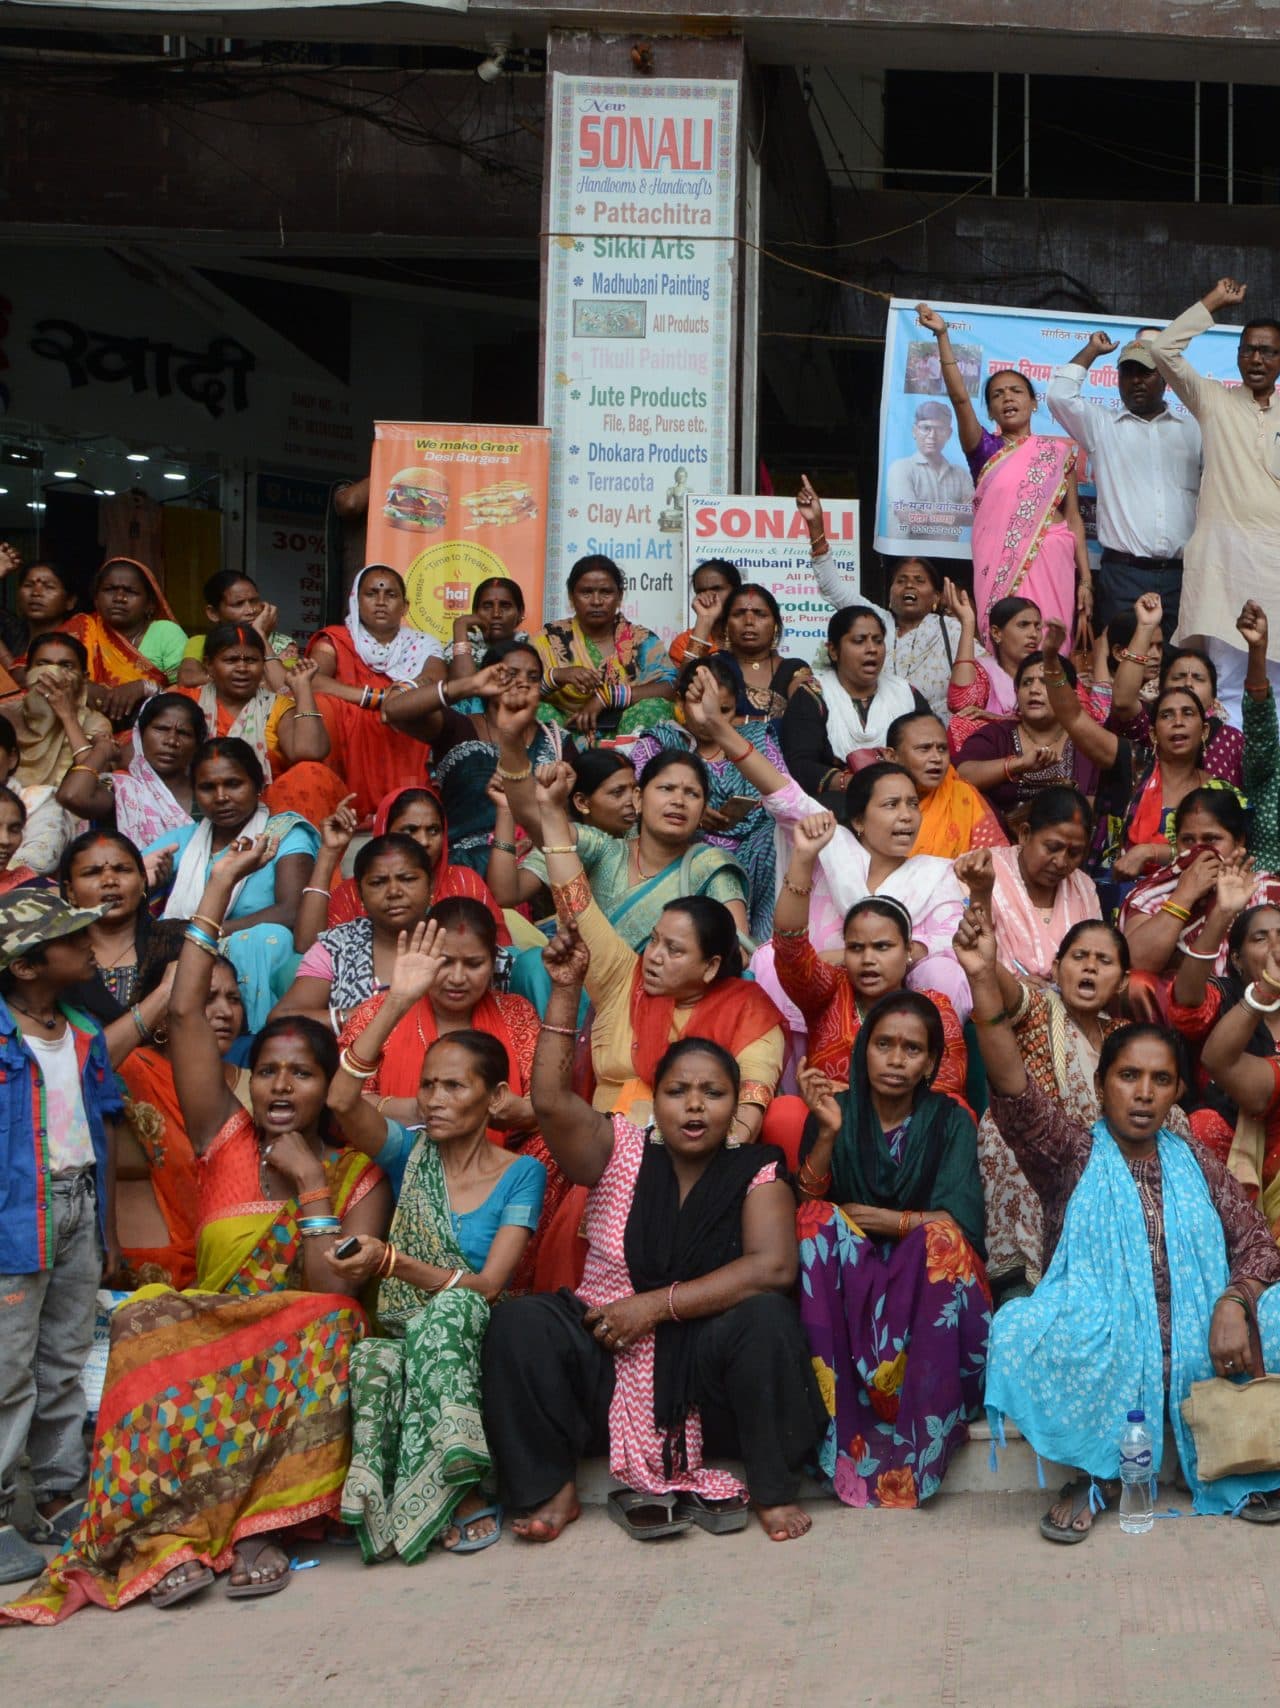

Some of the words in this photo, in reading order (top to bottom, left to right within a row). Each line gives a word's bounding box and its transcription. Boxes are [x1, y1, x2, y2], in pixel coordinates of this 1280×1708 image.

[579, 98, 626, 113] New
[578, 115, 714, 171] SONALI
[577, 175, 637, 194] Handlooms
[639, 178, 647, 193] &
[649, 177, 713, 200] Handicrafts
[593, 200, 712, 225] Pattachitra
[593, 236, 646, 259] Sikki
[651, 238, 696, 260] Arts
[592, 272, 659, 296] Madhubani
[661, 273, 711, 301] Painting
[652, 314, 665, 333] All
[667, 314, 710, 334] Products
[591, 346, 635, 370] Tikuli
[639, 348, 710, 375] Painting
[588, 385, 625, 407] Jute
[630, 386, 708, 408] Products
[656, 415, 685, 433] Purse
[687, 416, 708, 433] etc.
[416, 439, 437, 449] We
[439, 440, 478, 451] make
[480, 442, 520, 453] Great
[588, 442, 644, 463] Dhokara
[648, 443, 709, 464] Products
[424, 451, 455, 462] Desi
[455, 452, 511, 465] Burgers
[587, 471, 654, 492] Terracota
[587, 503, 622, 528] Clay
[626, 504, 652, 524] Art
[695, 507, 854, 540] SONALI
[272, 531, 326, 555] 30%
[586, 537, 641, 560] Sujani
[646, 538, 673, 560] Art
[640, 572, 673, 592] Craft
[786, 573, 801, 582] All
